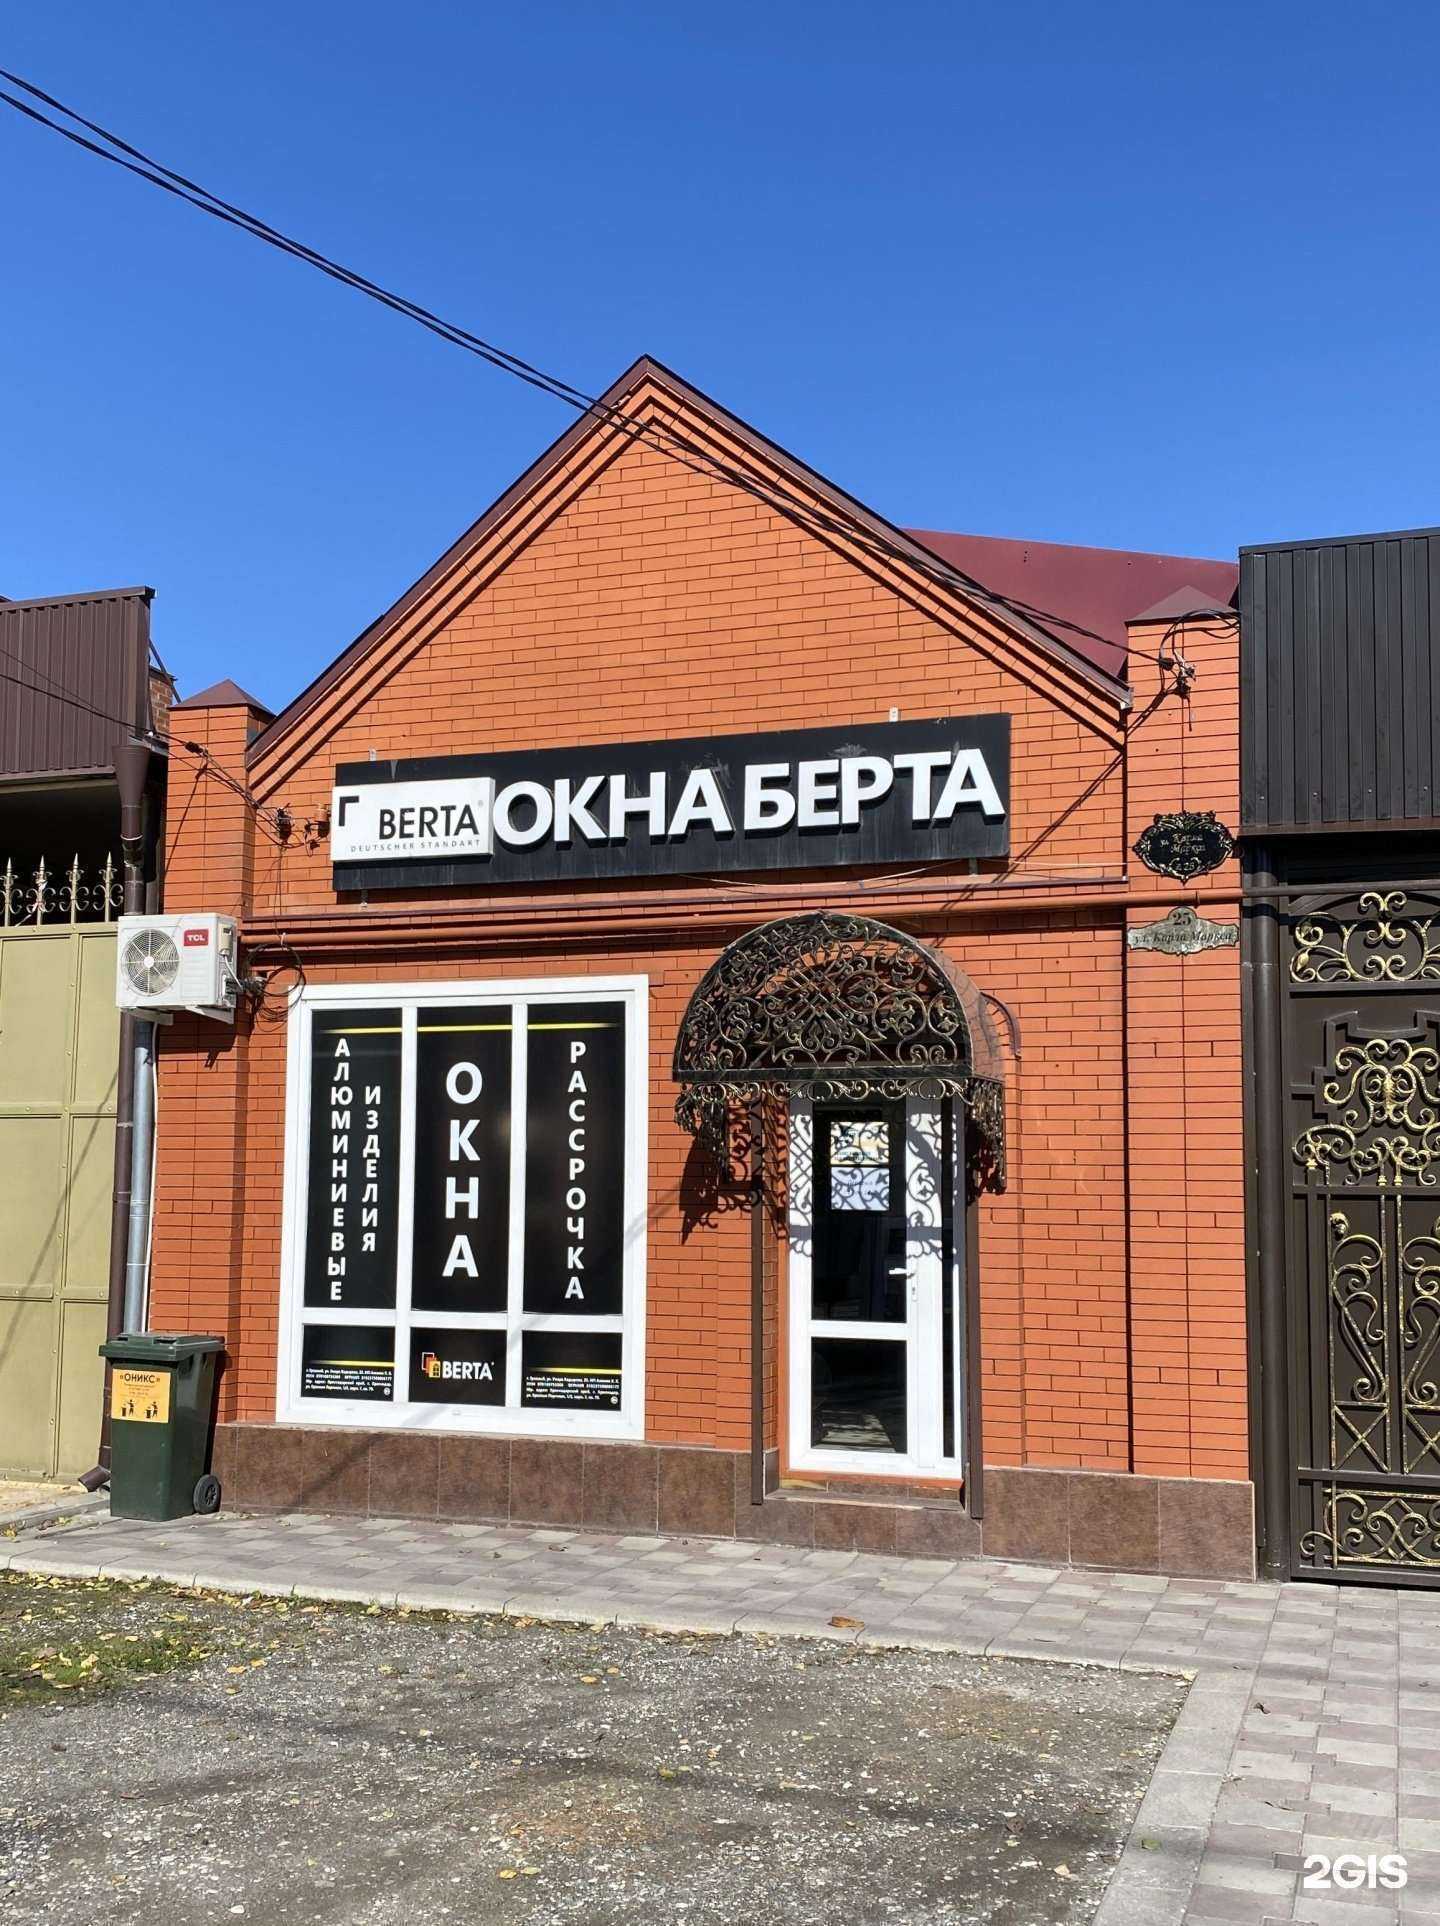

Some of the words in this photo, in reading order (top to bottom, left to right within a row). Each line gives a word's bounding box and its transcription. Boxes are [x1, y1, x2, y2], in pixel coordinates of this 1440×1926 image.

[379, 804, 480, 840] BERTA
[492, 767, 734, 847] ОКНА
[744, 748, 1006, 832] БЕРТА
[350, 842, 414, 853] DEUTSCHER
[420, 839, 481, 849] STANDART
[187, 934, 206, 942] TCL
[1172, 912, 1191, 926] 25
[327, 1037, 353, 1301] АЛЮМИНИЕВЫЕ
[361, 1085, 382, 1253] ИЗДЕЛИЯ
[442, 1061, 484, 1278] ОКНА
[565, 1040, 588, 1300] РАССРОЧКА
[442, 1360, 493, 1380] BERTA
